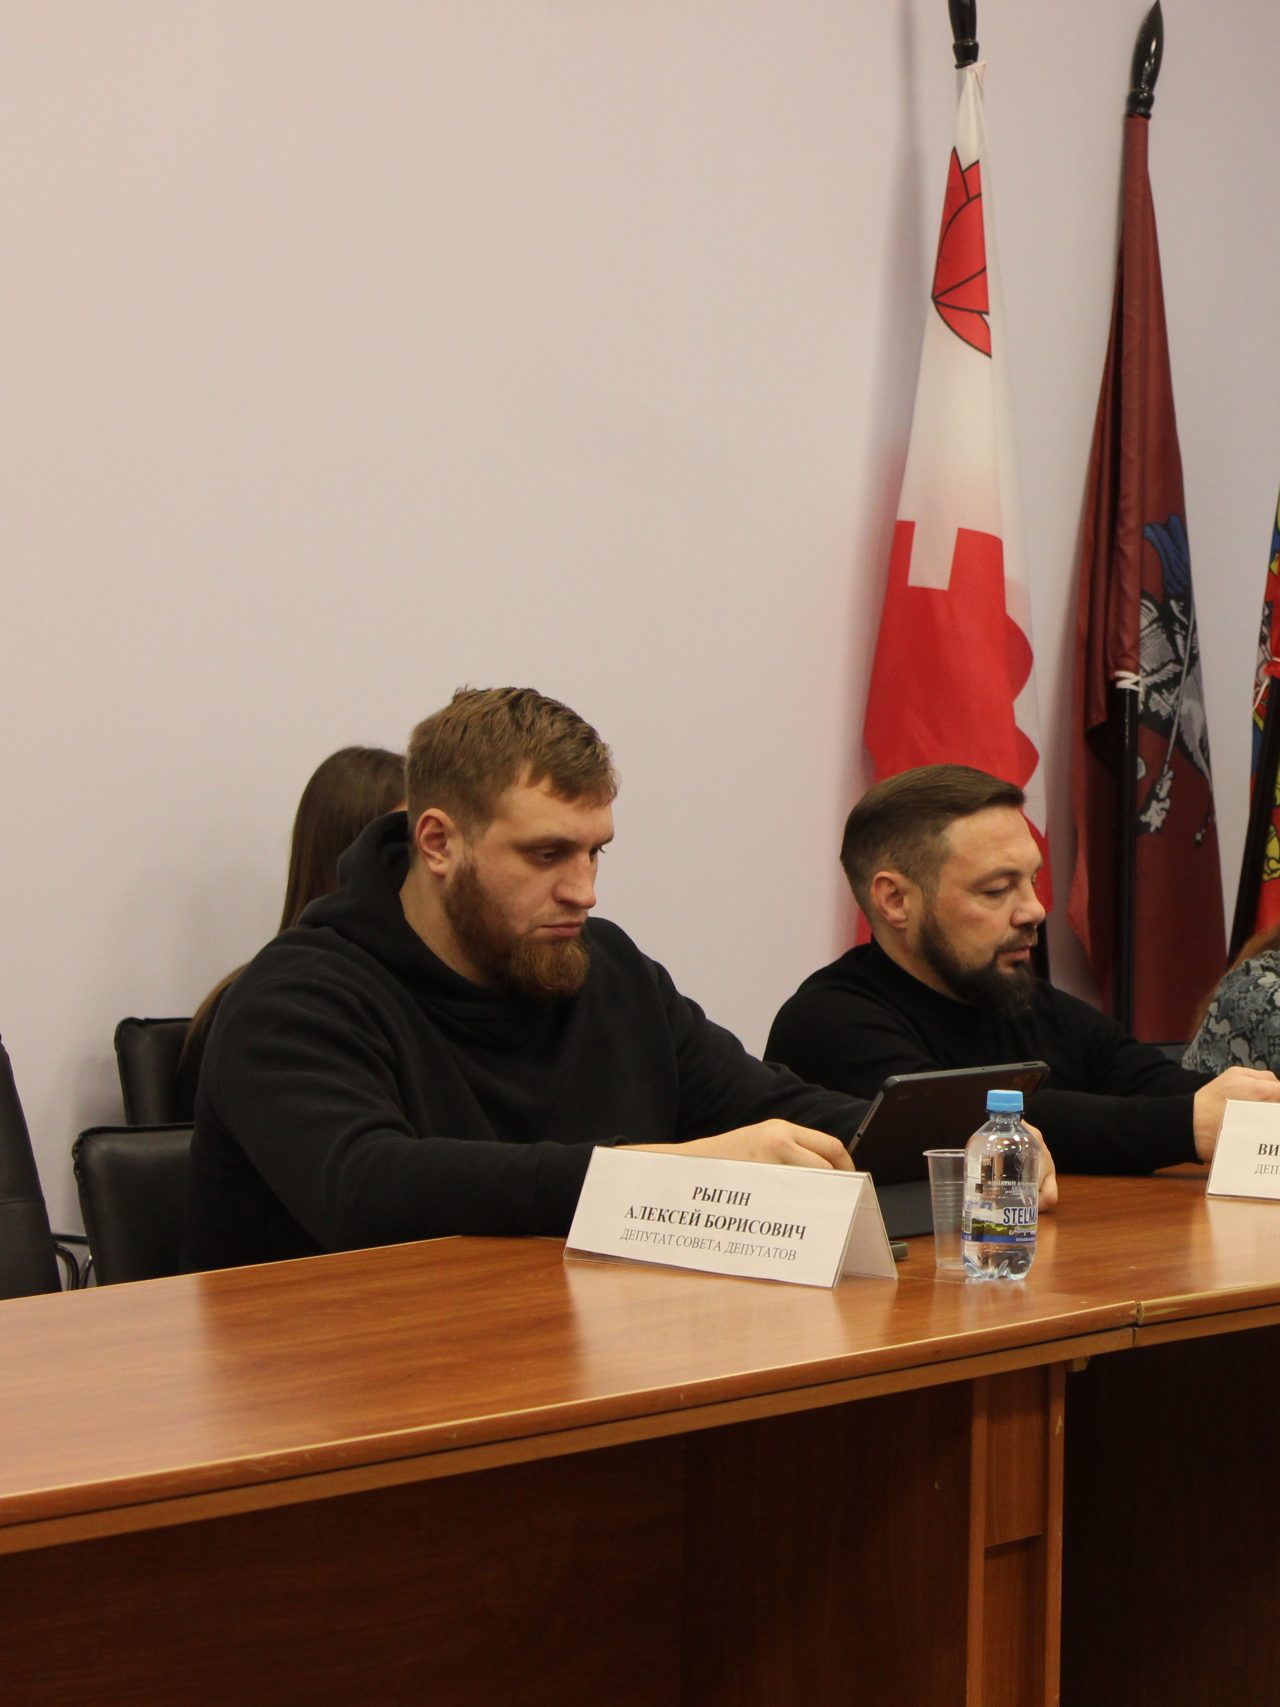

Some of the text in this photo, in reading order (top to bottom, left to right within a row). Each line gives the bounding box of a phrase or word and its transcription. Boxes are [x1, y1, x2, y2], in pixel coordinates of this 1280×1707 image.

[692, 1186, 751, 1207] РЫГИН
[624, 1204, 807, 1240] АЛЕКСЕЙ БОРИСОВИЧ
[620, 1228, 797, 1261] ДЕПУТАТ СОВЕТА ДЕПУТАТОВ
